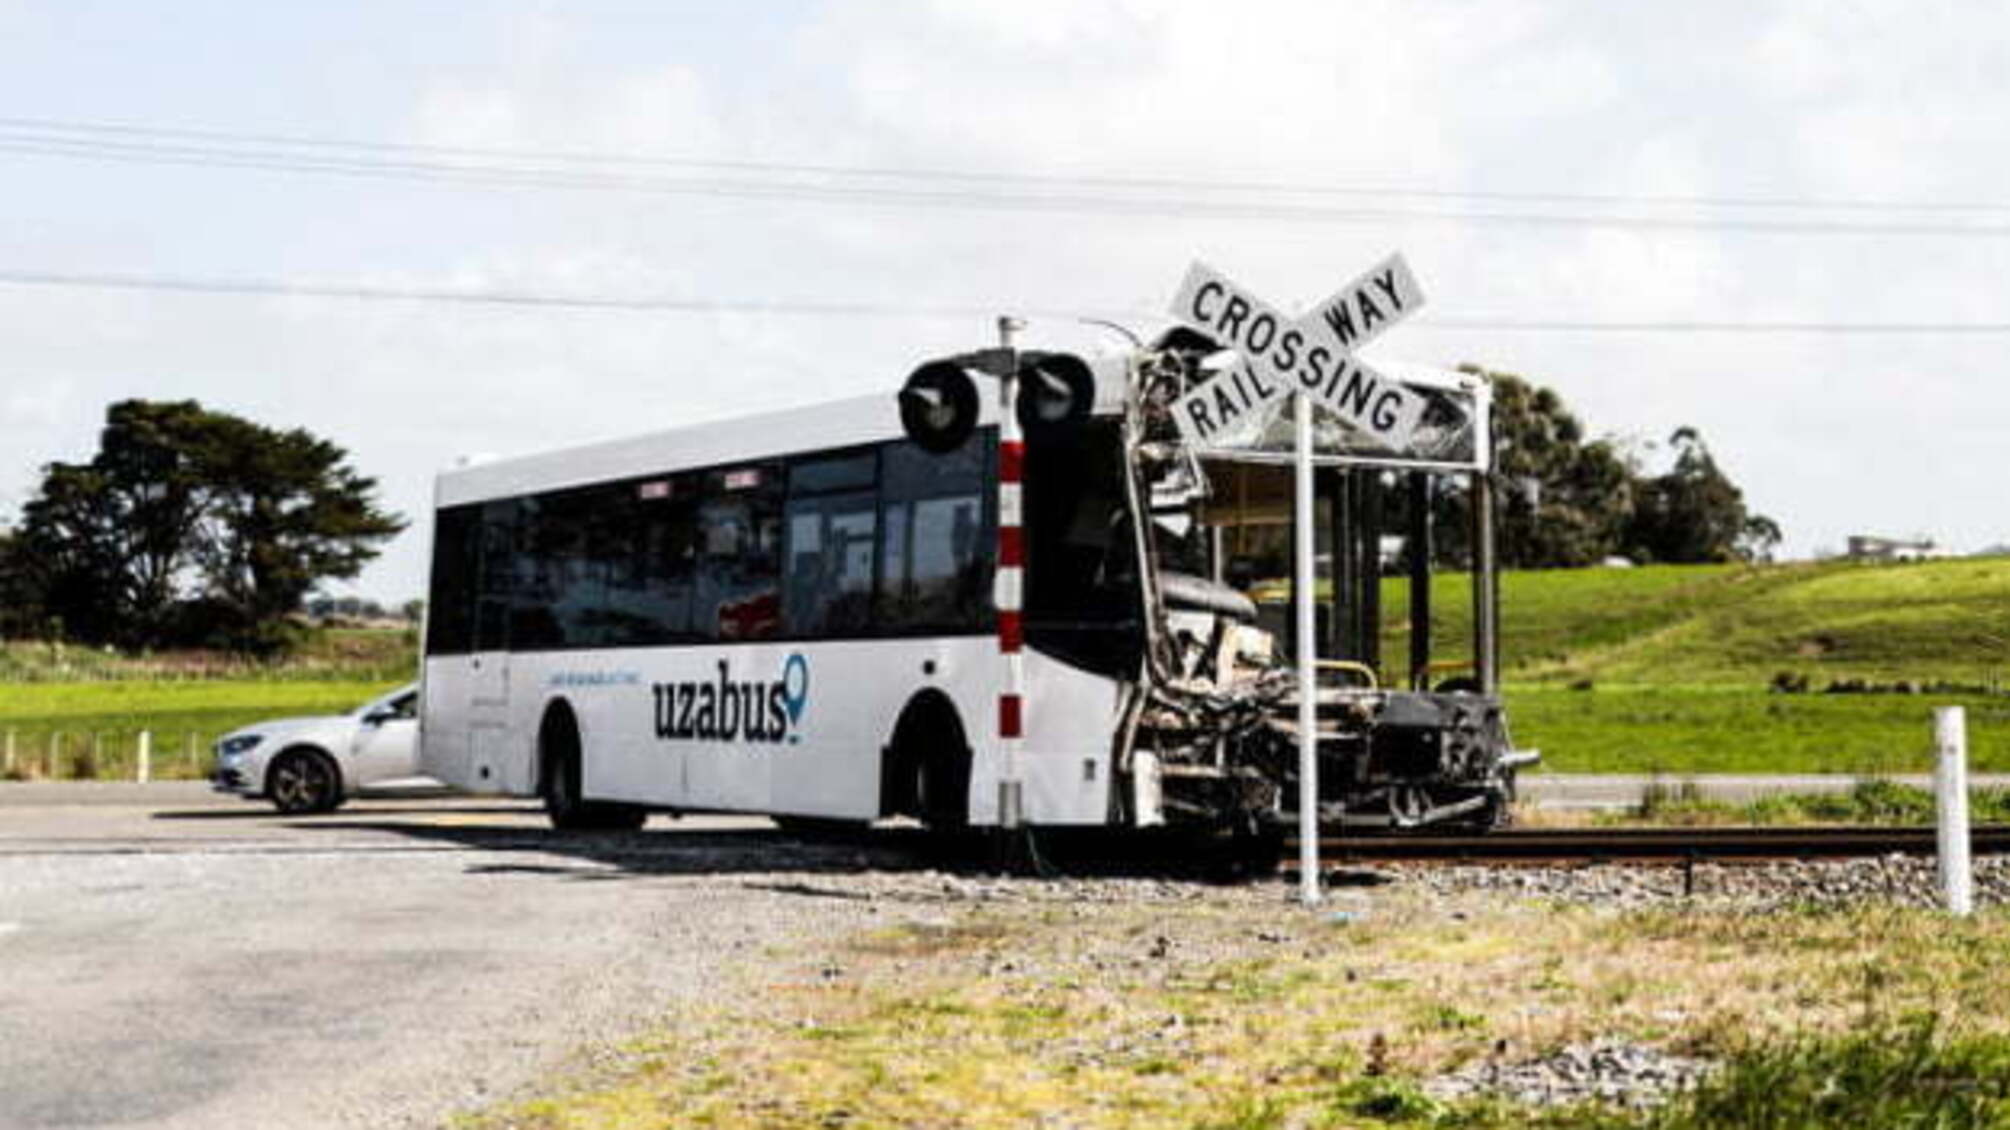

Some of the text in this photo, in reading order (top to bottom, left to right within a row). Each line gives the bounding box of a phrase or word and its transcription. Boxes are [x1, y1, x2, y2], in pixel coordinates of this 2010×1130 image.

[1187, 269, 1402, 438] RAIL WAY
[1193, 282, 1402, 431] CROSSING
